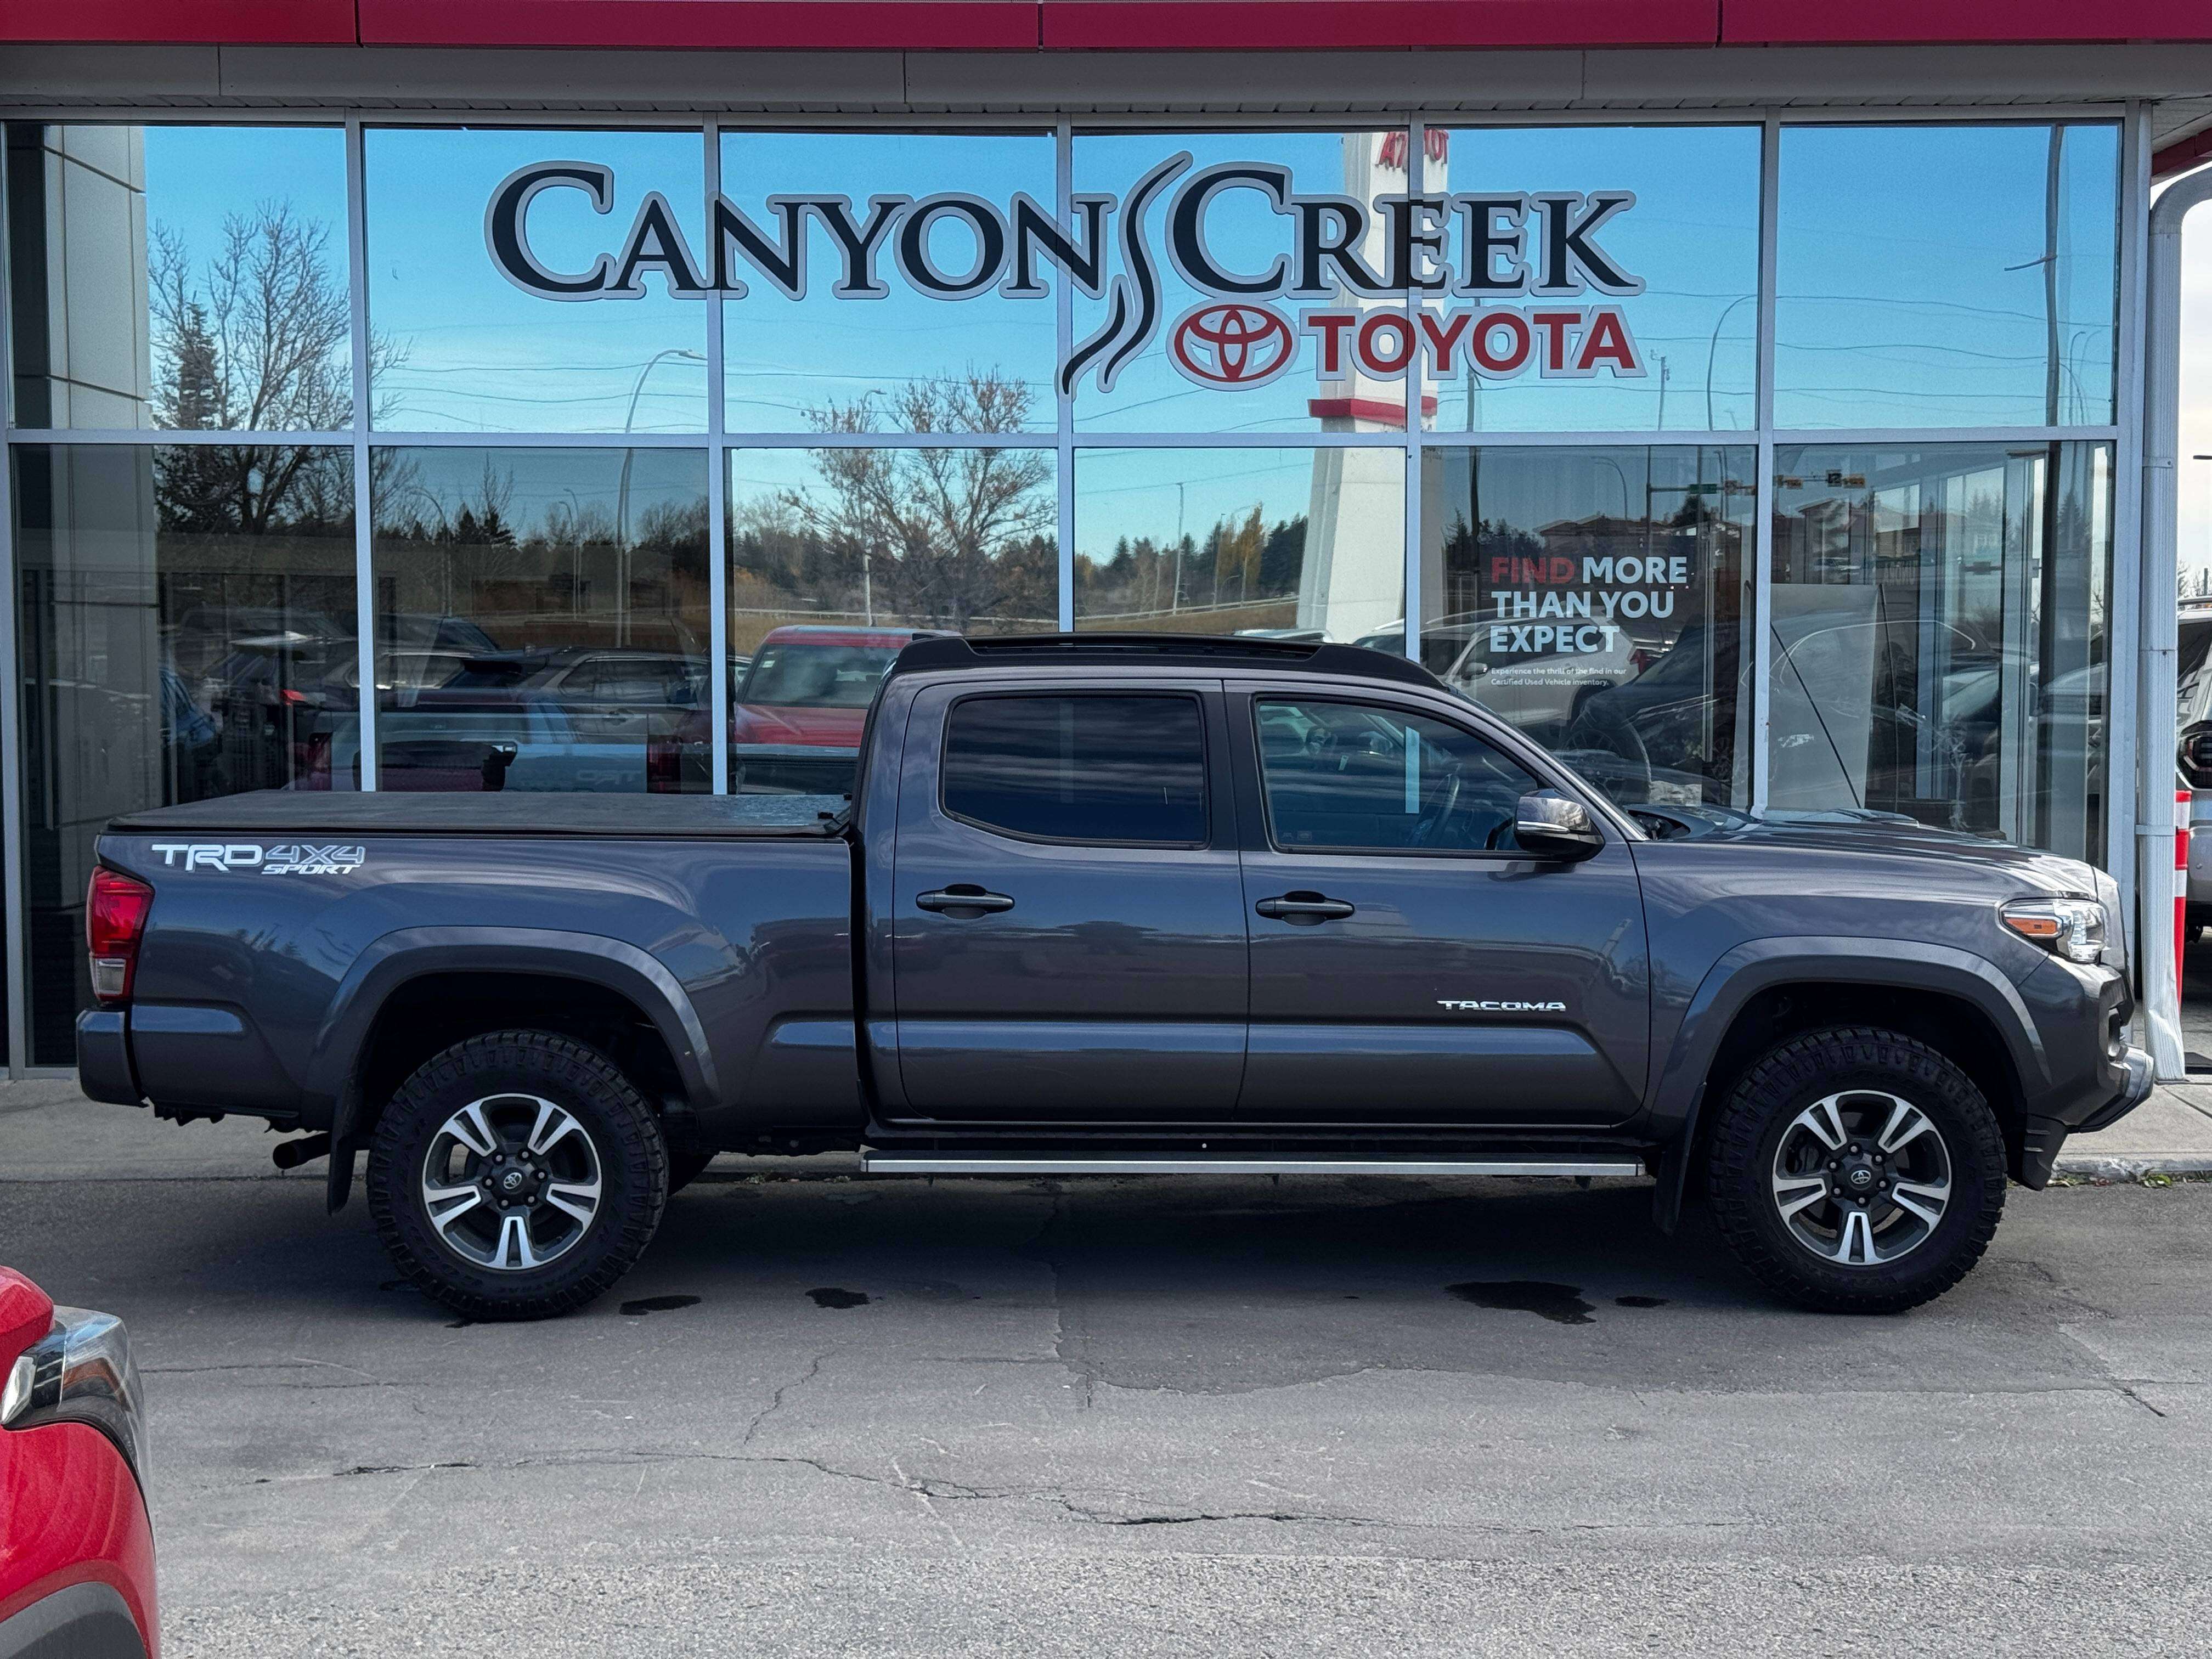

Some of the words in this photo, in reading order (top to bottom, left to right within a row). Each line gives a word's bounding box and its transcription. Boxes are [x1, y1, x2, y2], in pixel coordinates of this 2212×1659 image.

[486, 162, 1116, 300] CANYON
[1166, 163, 1644, 300] CREEK
[1304, 308, 1643, 377] TOYOTA
[1491, 557, 1575, 583] FIND
[1583, 557, 1687, 583] MORE
[1492, 591, 1590, 618] THAN
[1597, 591, 1674, 618] YOU
[1489, 625, 1620, 652] EXPECT
[151, 844, 264, 873] TRD
[262, 864, 360, 874] SPORT
[1437, 1000, 1566, 1012] TACOMA
